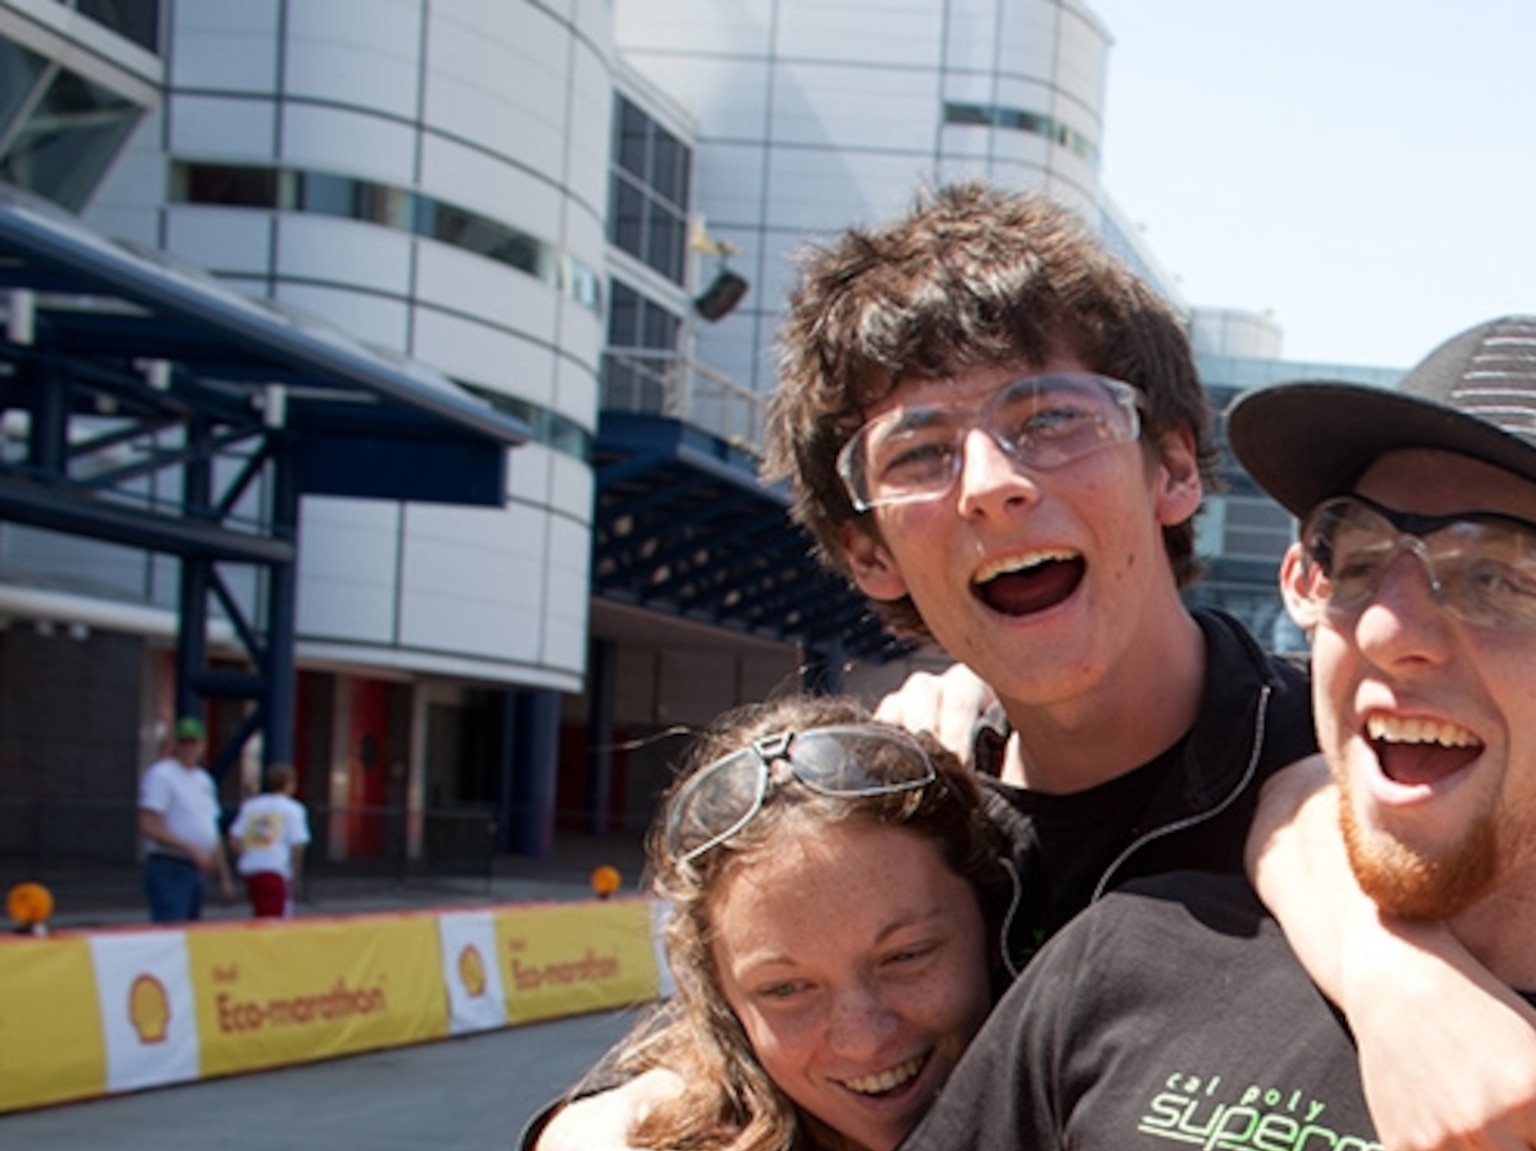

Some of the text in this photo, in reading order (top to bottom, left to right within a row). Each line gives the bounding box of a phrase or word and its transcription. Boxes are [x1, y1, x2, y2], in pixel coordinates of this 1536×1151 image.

[217, 976, 386, 1034] Eco-marathon
[1167, 1073, 1325, 1121] cal poly
